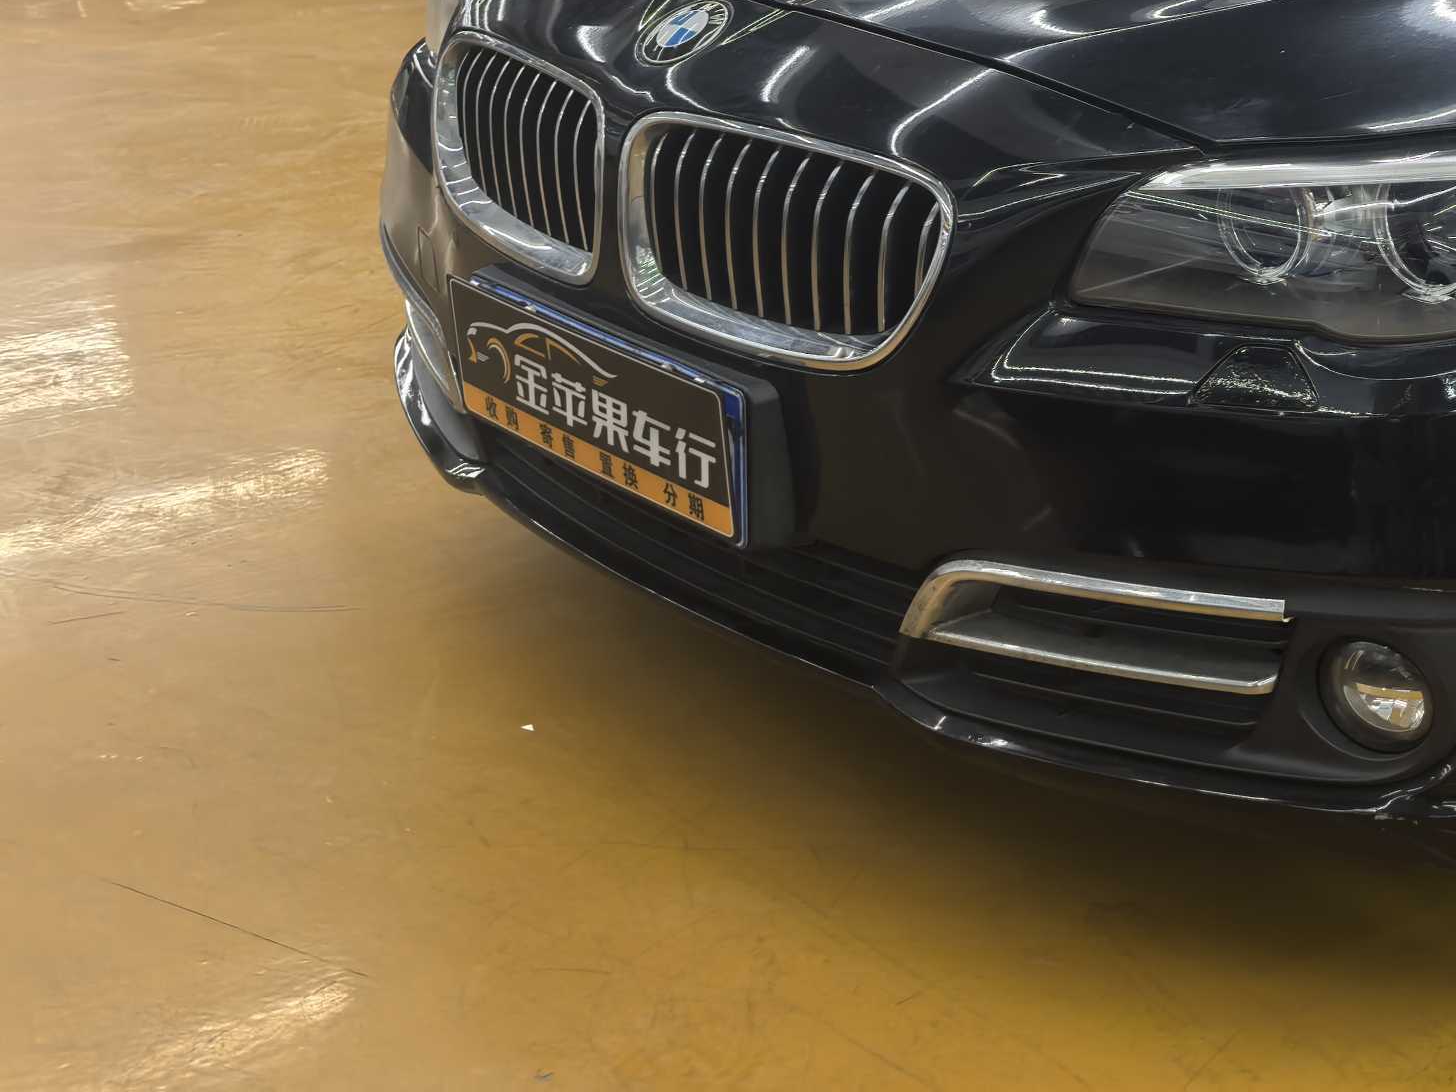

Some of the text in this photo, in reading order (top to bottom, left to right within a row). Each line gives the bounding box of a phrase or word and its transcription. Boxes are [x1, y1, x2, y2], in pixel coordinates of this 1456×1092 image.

[484, 395, 704, 521] 收购 寄售 置换 分期
[514, 354, 716, 489] 金苹果车行
